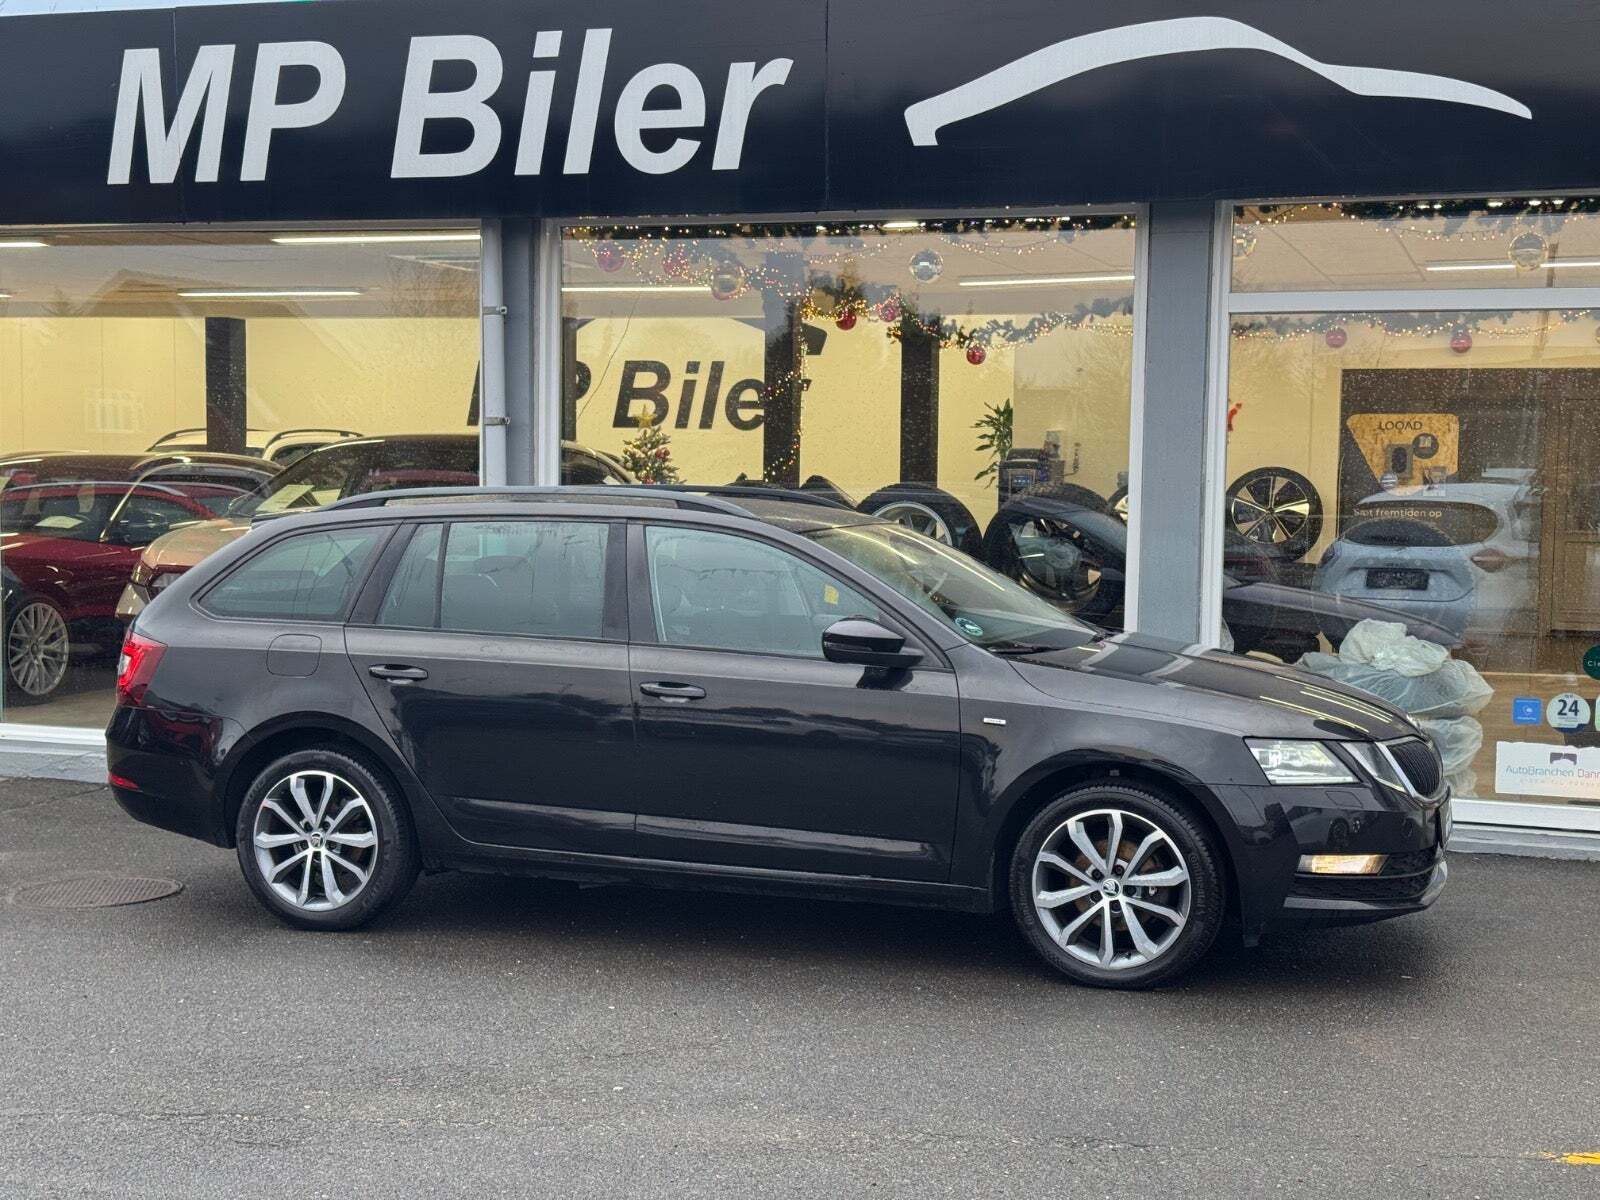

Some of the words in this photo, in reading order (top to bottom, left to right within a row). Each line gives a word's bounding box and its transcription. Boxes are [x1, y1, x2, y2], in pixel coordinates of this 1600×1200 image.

[107, 41, 346, 184] MP
[391, 28, 794, 178] Biler
[612, 360, 812, 431] Bile
[1429, 509, 1442, 519] op
[1557, 699, 1579, 716] 24
[1505, 765, 1574, 777] AutoBranchen
